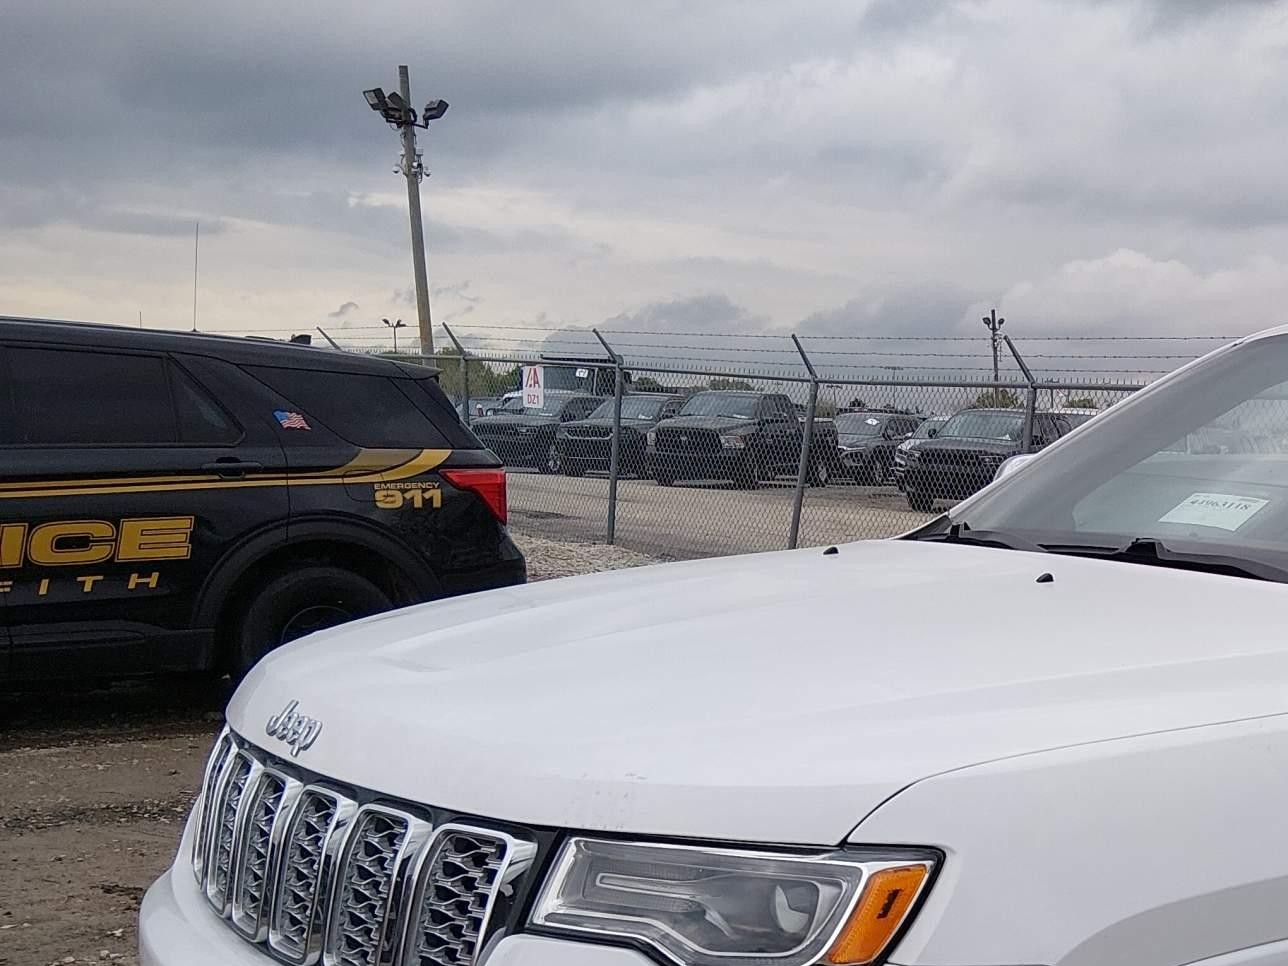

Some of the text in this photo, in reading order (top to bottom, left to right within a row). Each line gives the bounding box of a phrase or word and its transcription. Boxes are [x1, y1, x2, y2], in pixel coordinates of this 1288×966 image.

[374, 482, 440, 490] EMERGENCY
[374, 490, 442, 509] 911
[266, 699, 323, 758] Jeep
